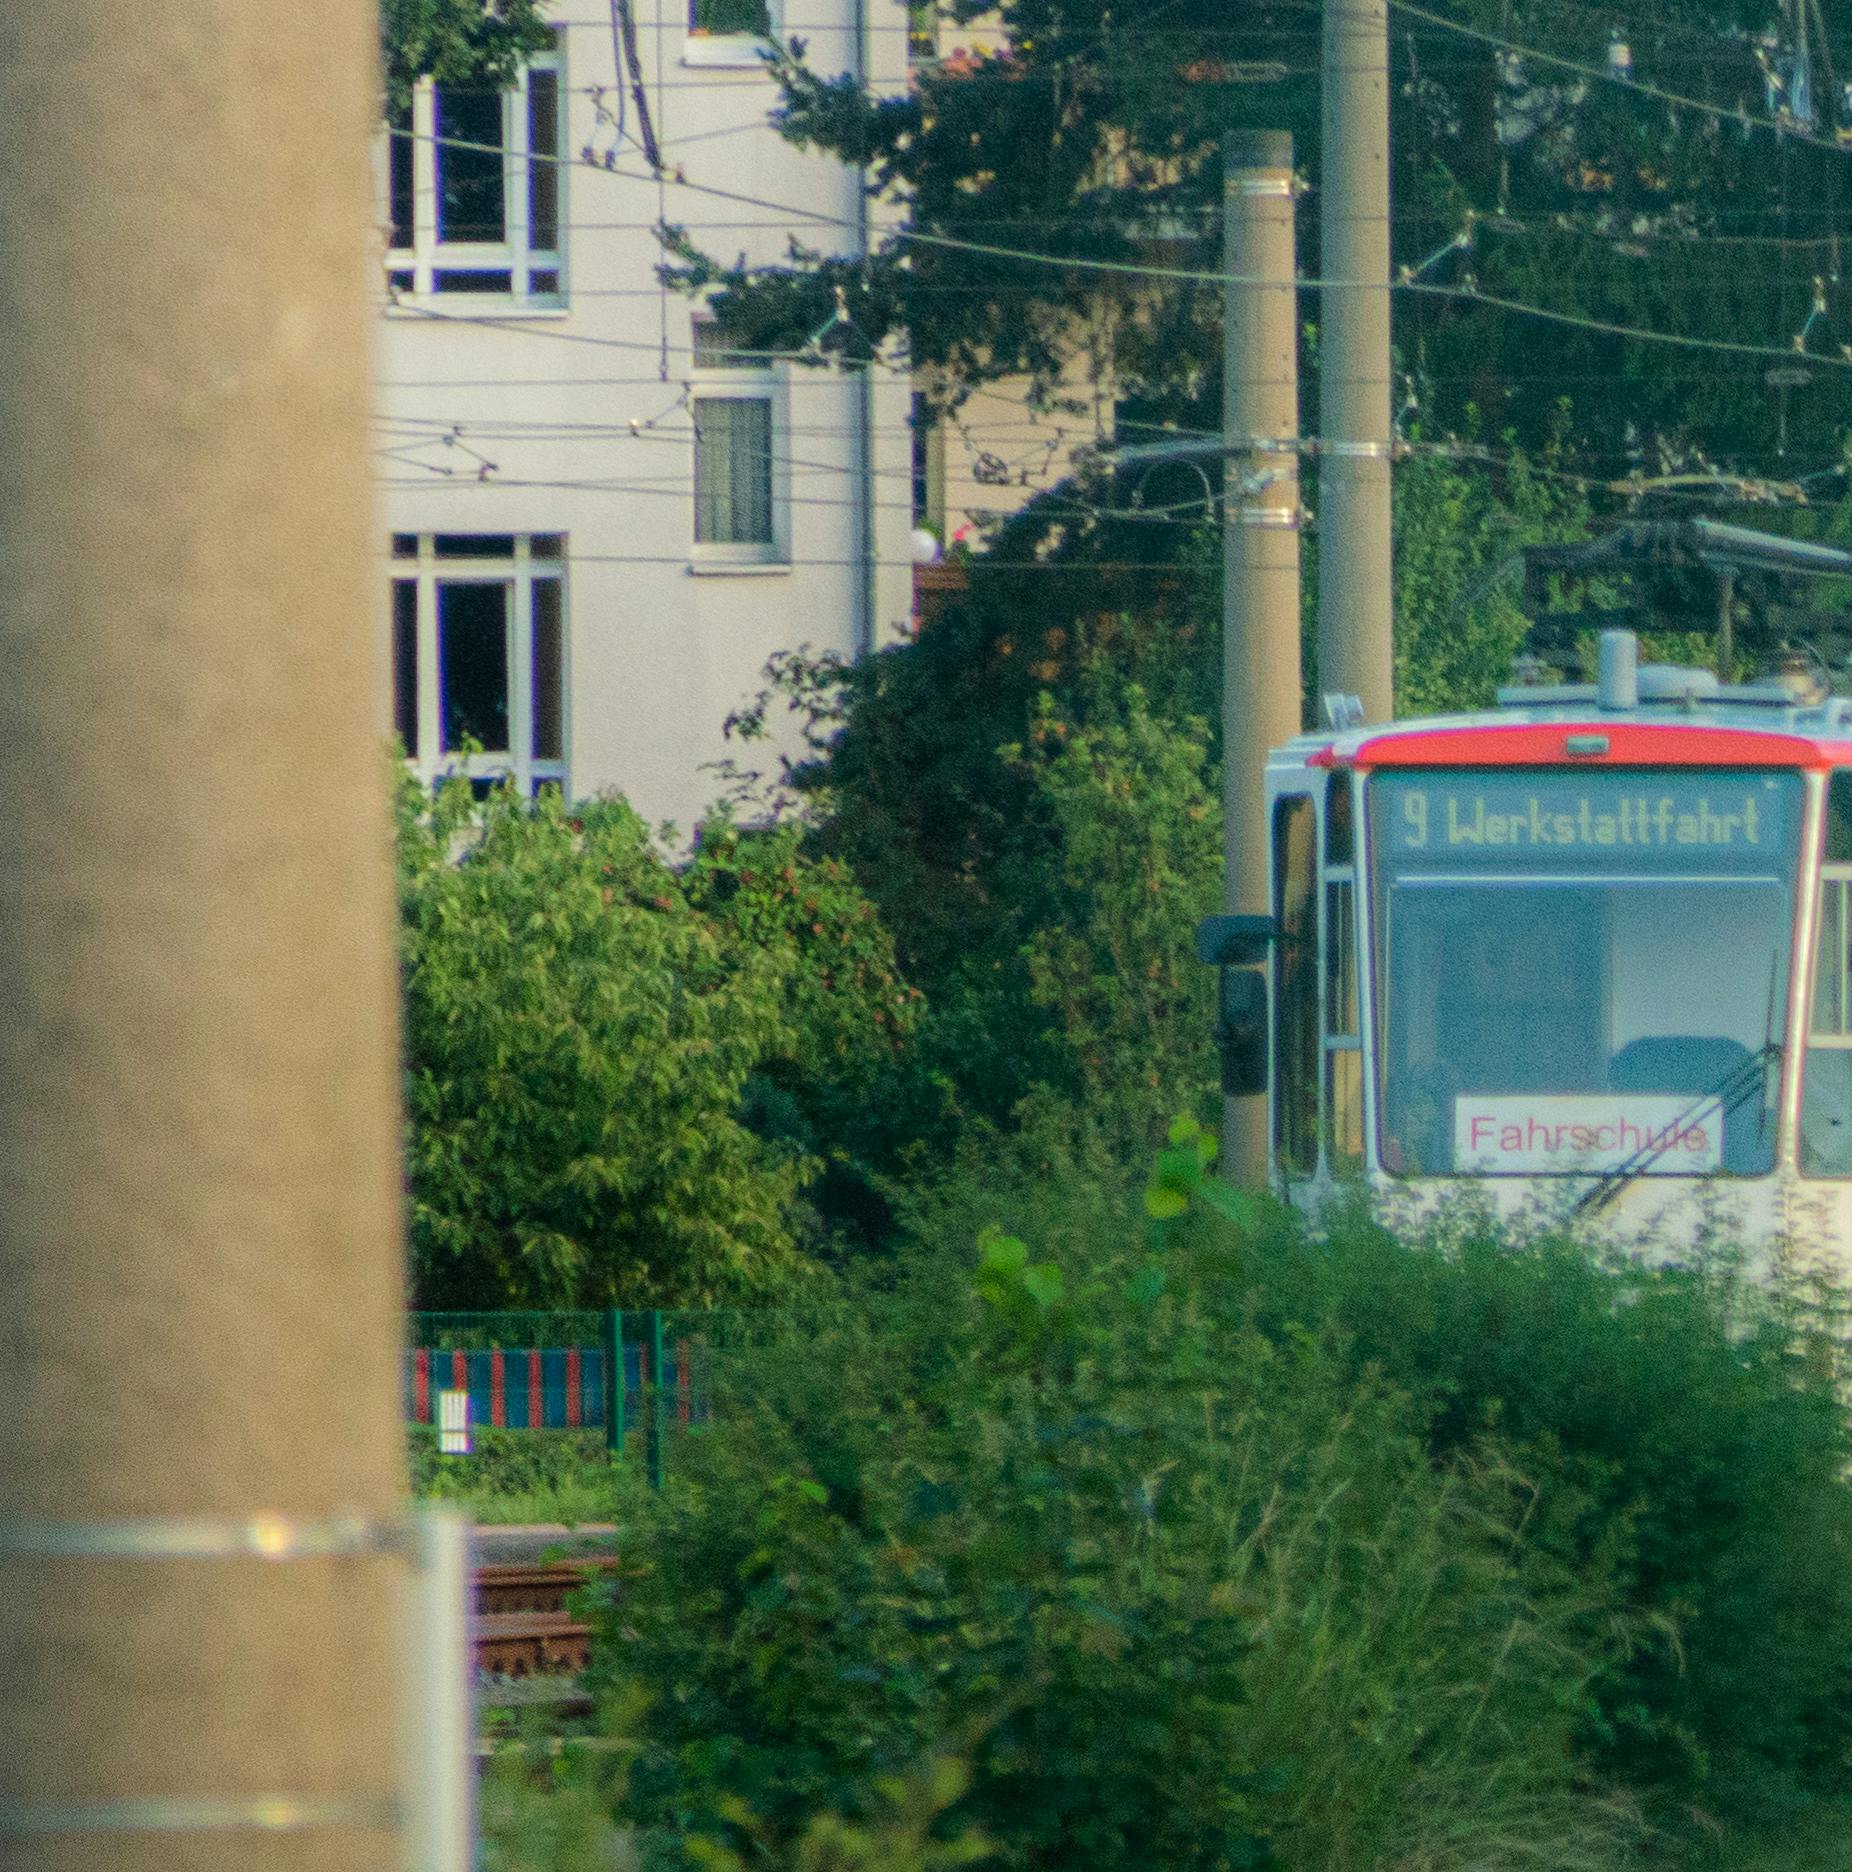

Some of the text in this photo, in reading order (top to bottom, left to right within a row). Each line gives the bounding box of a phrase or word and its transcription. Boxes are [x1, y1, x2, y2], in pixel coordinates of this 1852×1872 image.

[1404, 791, 1760, 848] 9 Werkstattfahrt
[1470, 1116, 1709, 1152] Fahrschule
